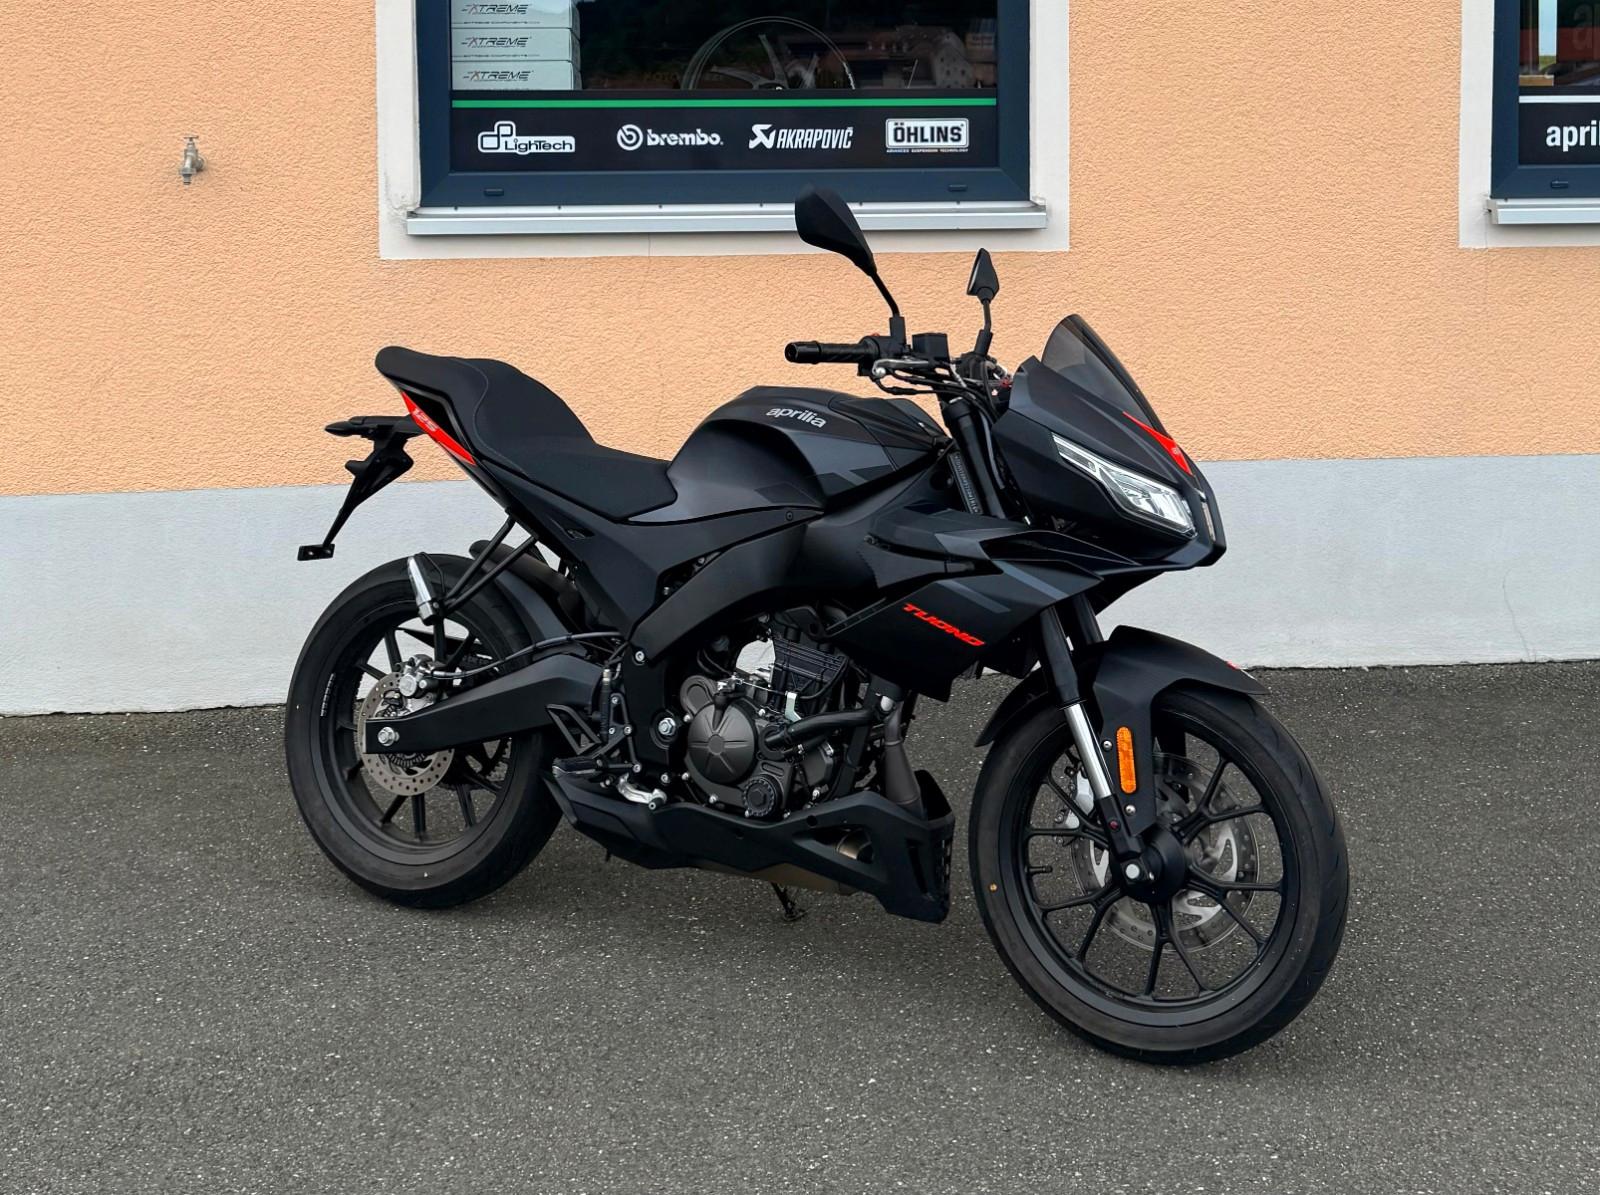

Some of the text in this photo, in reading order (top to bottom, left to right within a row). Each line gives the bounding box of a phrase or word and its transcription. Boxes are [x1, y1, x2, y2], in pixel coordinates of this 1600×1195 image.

[647, 128, 721, 146] brembo
[893, 122, 962, 143] ÖHLINS
[1545, 119, 1600, 152] apri
[765, 407, 827, 428] aprilia
